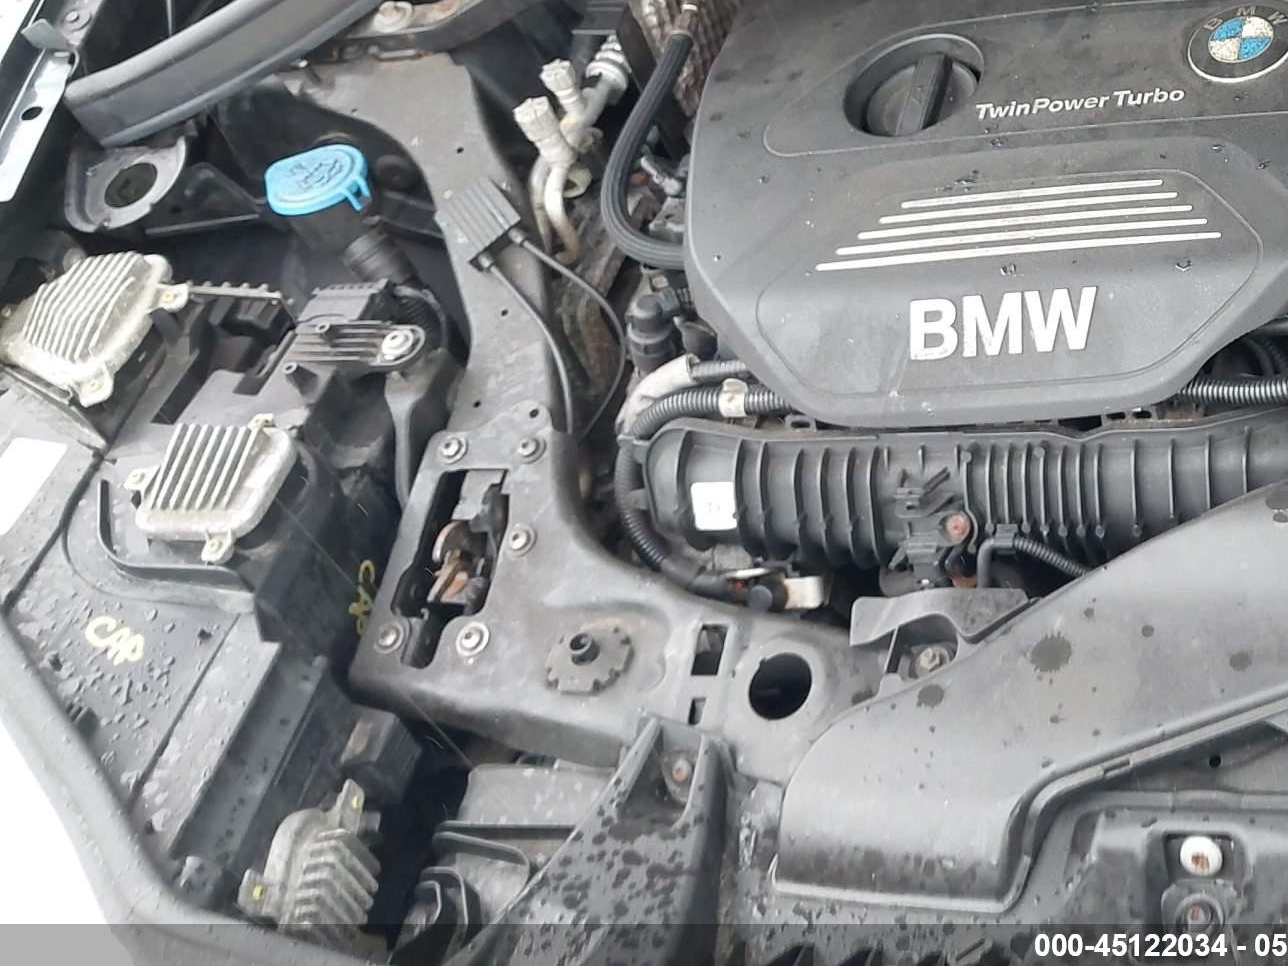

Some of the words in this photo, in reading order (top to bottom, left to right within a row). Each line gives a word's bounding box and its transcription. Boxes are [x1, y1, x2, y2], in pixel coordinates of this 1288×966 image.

[1203, 5, 1288, 31] BMW
[976, 90, 1109, 121] TwinPower
[1112, 86, 1186, 109] Turbo
[909, 286, 1099, 362] BMW
